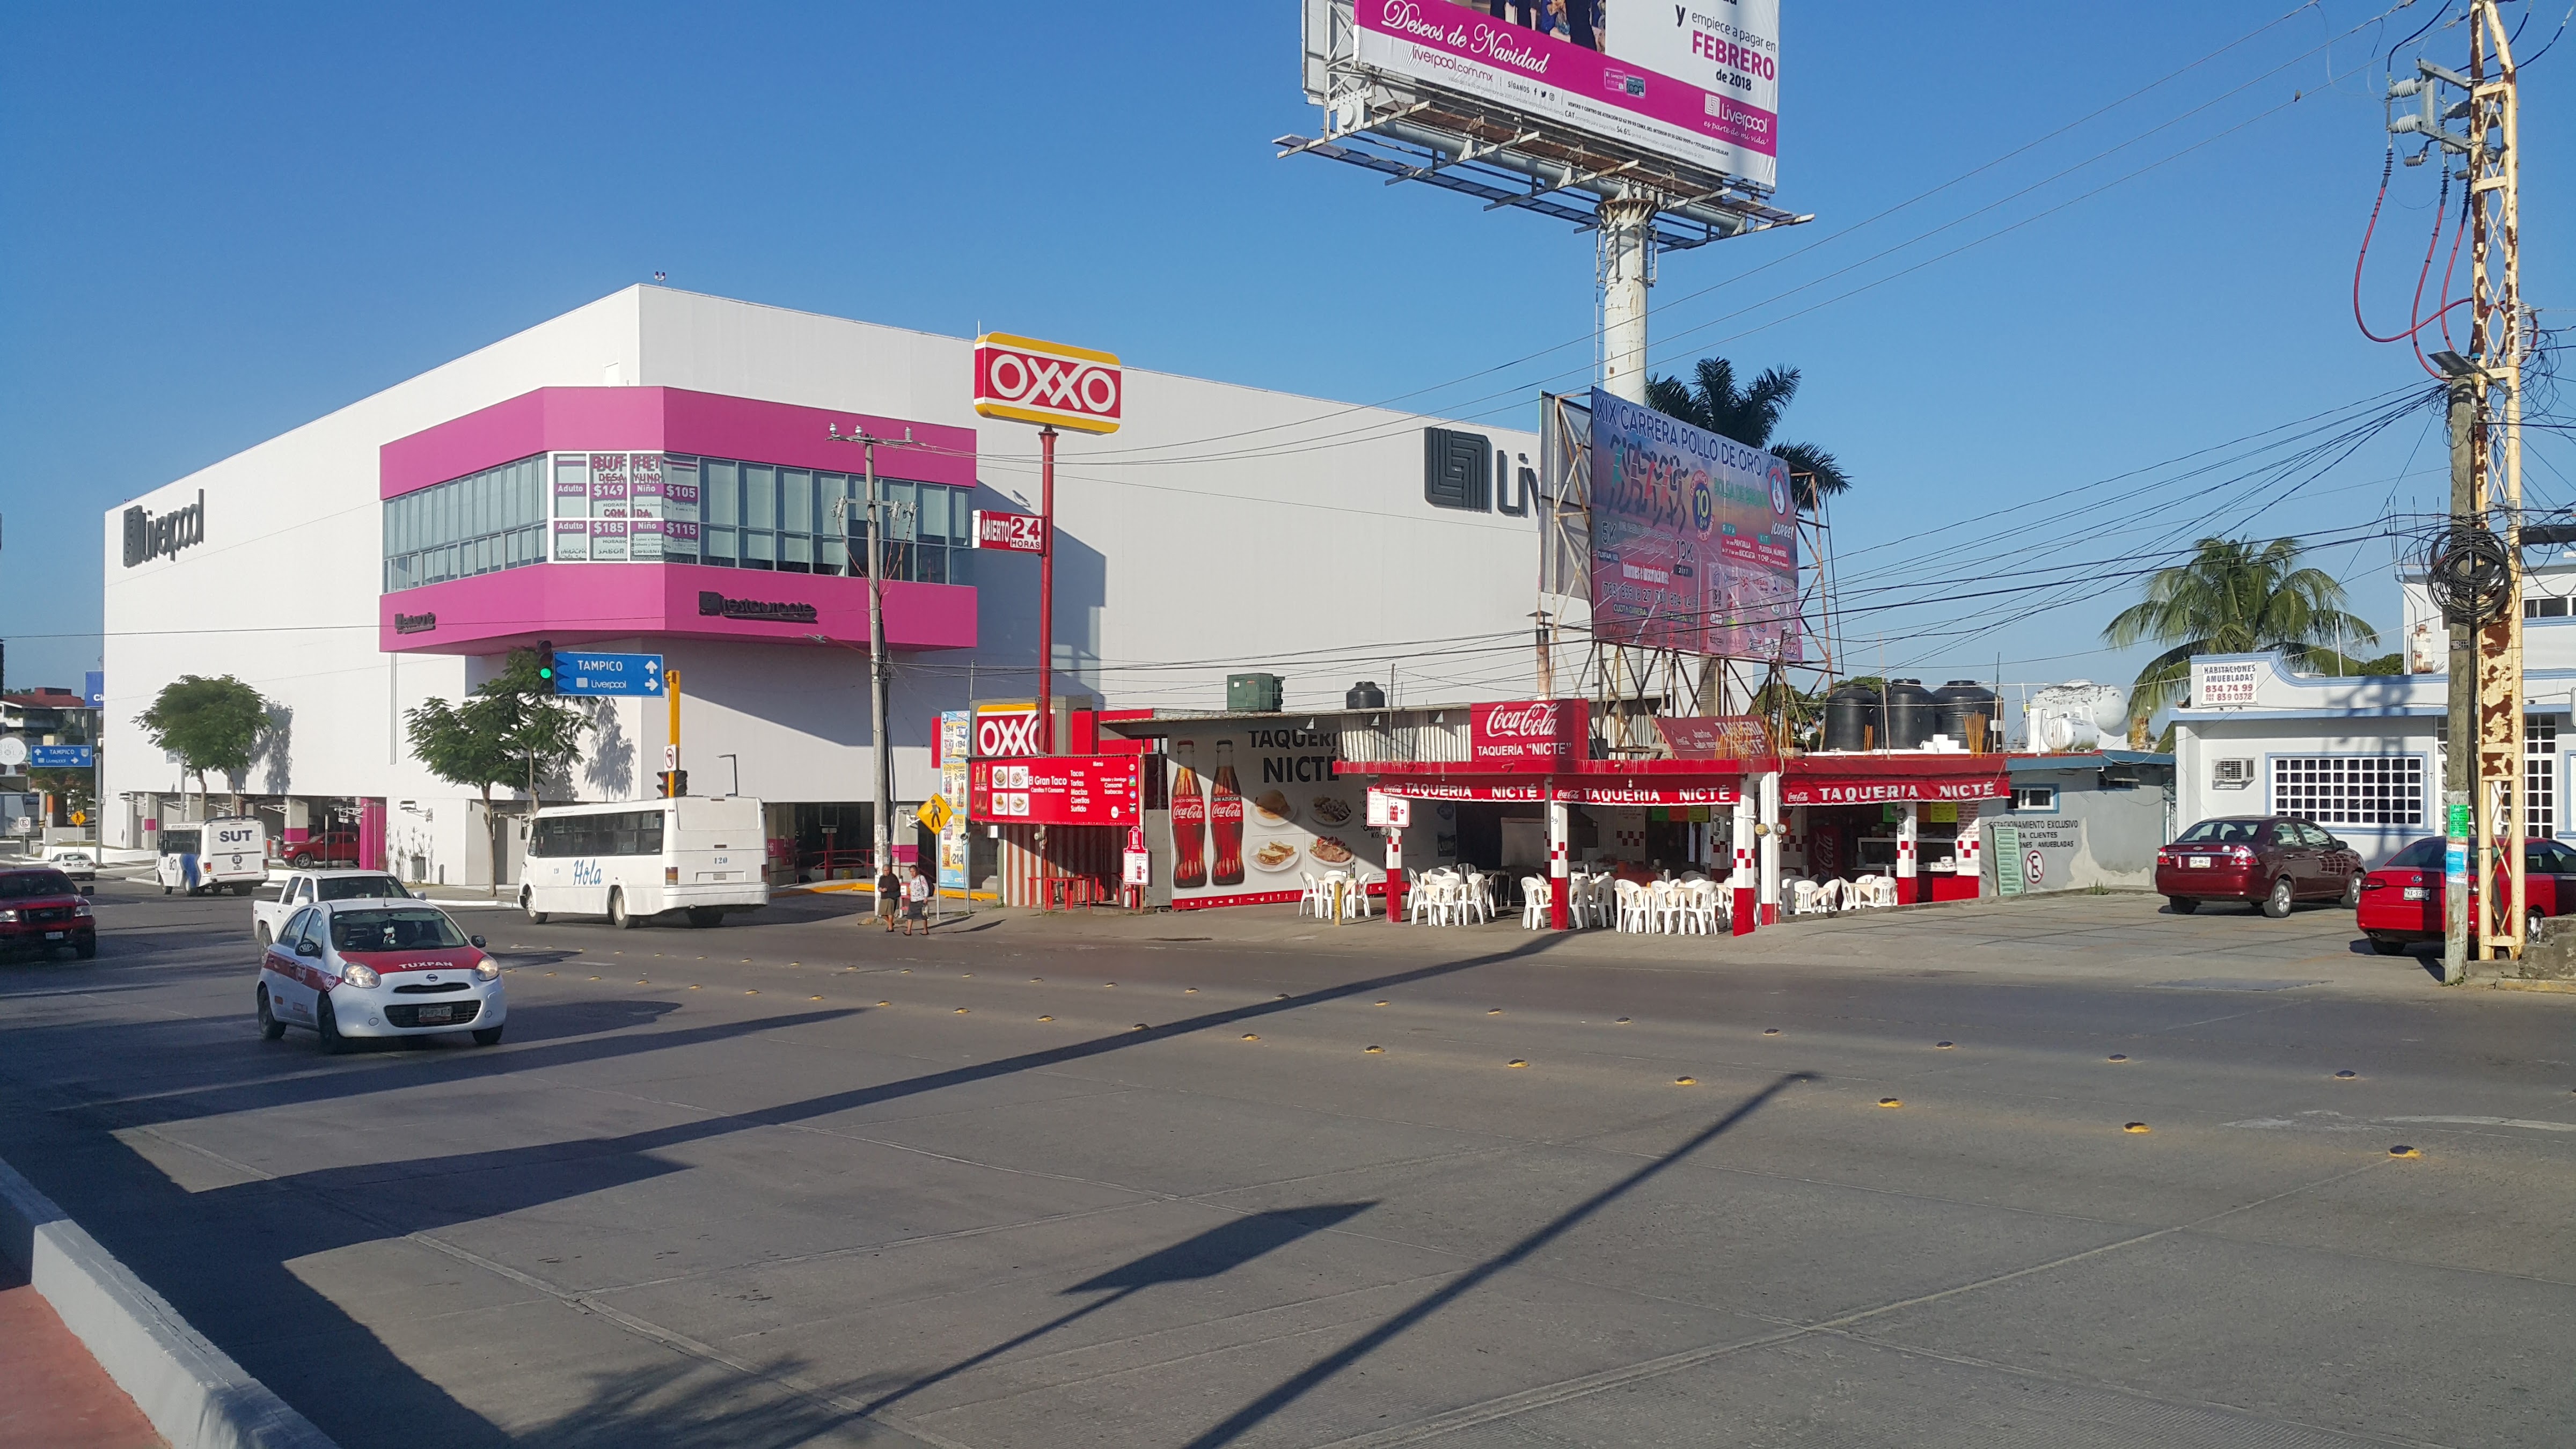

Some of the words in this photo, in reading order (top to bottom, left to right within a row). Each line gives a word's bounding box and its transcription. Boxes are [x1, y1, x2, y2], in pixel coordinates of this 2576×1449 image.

[1675, 4, 1686, 27] y
[1381, 0, 1444, 41] Deseos
[1447, 25, 1467, 48] de
[1470, 23, 1550, 74] Navidad
[1692, 12, 1730, 35] empiece
[1733, 27, 1737, 37] a
[1740, 30, 1764, 47] pagar
[1766, 41, 1776, 53] en
[1692, 30, 1775, 80] FEBRERO
[1412, 46, 1493, 82] liverpool.com.mx
[1716, 69, 1727, 83] de
[1729, 72, 1752, 91] 2018
[1721, 103, 1768, 134] Liverpool
[1712, 122, 1730, 134] parte
[1730, 127, 1739, 136] de
[991, 354, 1116, 413] OXXO
[1596, 394, 1617, 426] XIX
[1621, 405, 1678, 447] CARRERA
[1681, 427, 1717, 462] POLLO
[1721, 442, 1735, 468] DE
[1738, 449, 1761, 476] ORO
[594, 484, 624, 497] $149
[636, 484, 656, 493] Niño
[666, 485, 696, 498] $105
[1696, 489, 1709, 517] 10
[594, 522, 624, 534] $185
[666, 522, 696, 535] $115
[981, 519, 1009, 543] ABIERTO
[1012, 518, 1040, 540] 24
[1601, 521, 1616, 545] 5K
[1011, 540, 1040, 548] HORAS
[577, 660, 623, 671] TAMPICO
[2204, 665, 2256, 674] HABITACIONES
[591, 679, 627, 690] Liverpool
[2206, 674, 2253, 683] AMUEBLADAS
[2217, 693, 2231, 701] 839
[1486, 702, 1561, 737] Coca-Cola
[1248, 729, 1337, 749] TAQUERI
[1477, 743, 1523, 756] TAQUERÍA
[1029, 776, 1033, 785] El
[1035, 775, 1050, 785] Gran
[1051, 776, 1067, 785] Taco
[1404, 782, 1472, 797] TAQUERIA
[1492, 783, 1537, 798] NICTÉ
[1557, 789, 1579, 799] Coca-Cola
[1583, 787, 1660, 802] TAQUERIA
[1679, 785, 1730, 800] NICTÉ
[1819, 785, 1919, 801] TAQUERIA
[1939, 781, 1994, 798] NICTÉ
[1173, 804, 1203, 819] Coca-Cola
[1212, 803, 1241, 818] Coca-Cola
[2047, 820, 2078, 828] EXCLUSIVO
[219, 830, 253, 843] SUT
[573, 859, 602, 885] Hola
